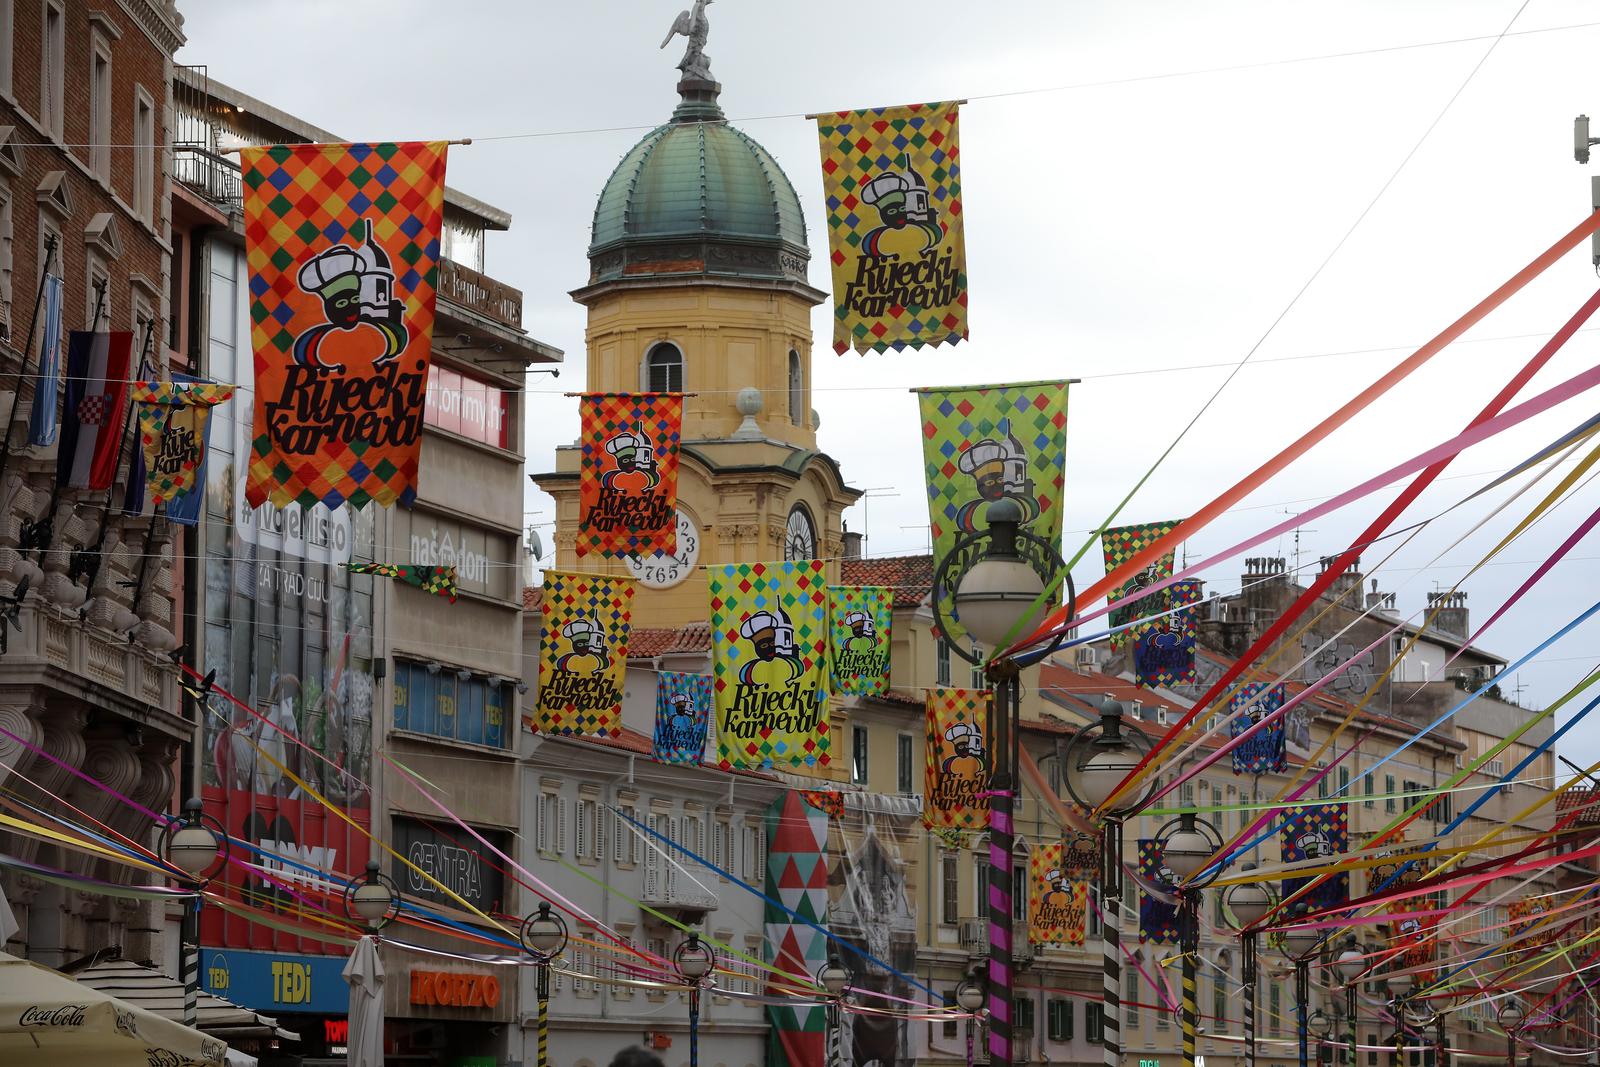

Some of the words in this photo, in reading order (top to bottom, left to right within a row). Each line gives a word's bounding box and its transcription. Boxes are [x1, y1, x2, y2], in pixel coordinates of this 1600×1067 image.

[844, 268, 961, 318] karneval
[264, 392, 426, 456] karneval
[585, 504, 671, 532] karneval
[681, 521, 689, 537] 2
[686, 537, 695, 553] 3
[458, 537, 489, 585] dom
[645, 566, 655, 580] 7
[668, 564, 678, 579] 5
[655, 567, 666, 583] 6
[394, 687, 407, 706] EDi
[723, 701, 820, 739] karneval
[409, 841, 482, 899] CENTRA
[208, 967, 229, 990] TEDi
[271, 961, 311, 1004] TEDi
[411, 969, 500, 1008] KORZO
[19, 1005, 88, 1026] Coca-Cola
